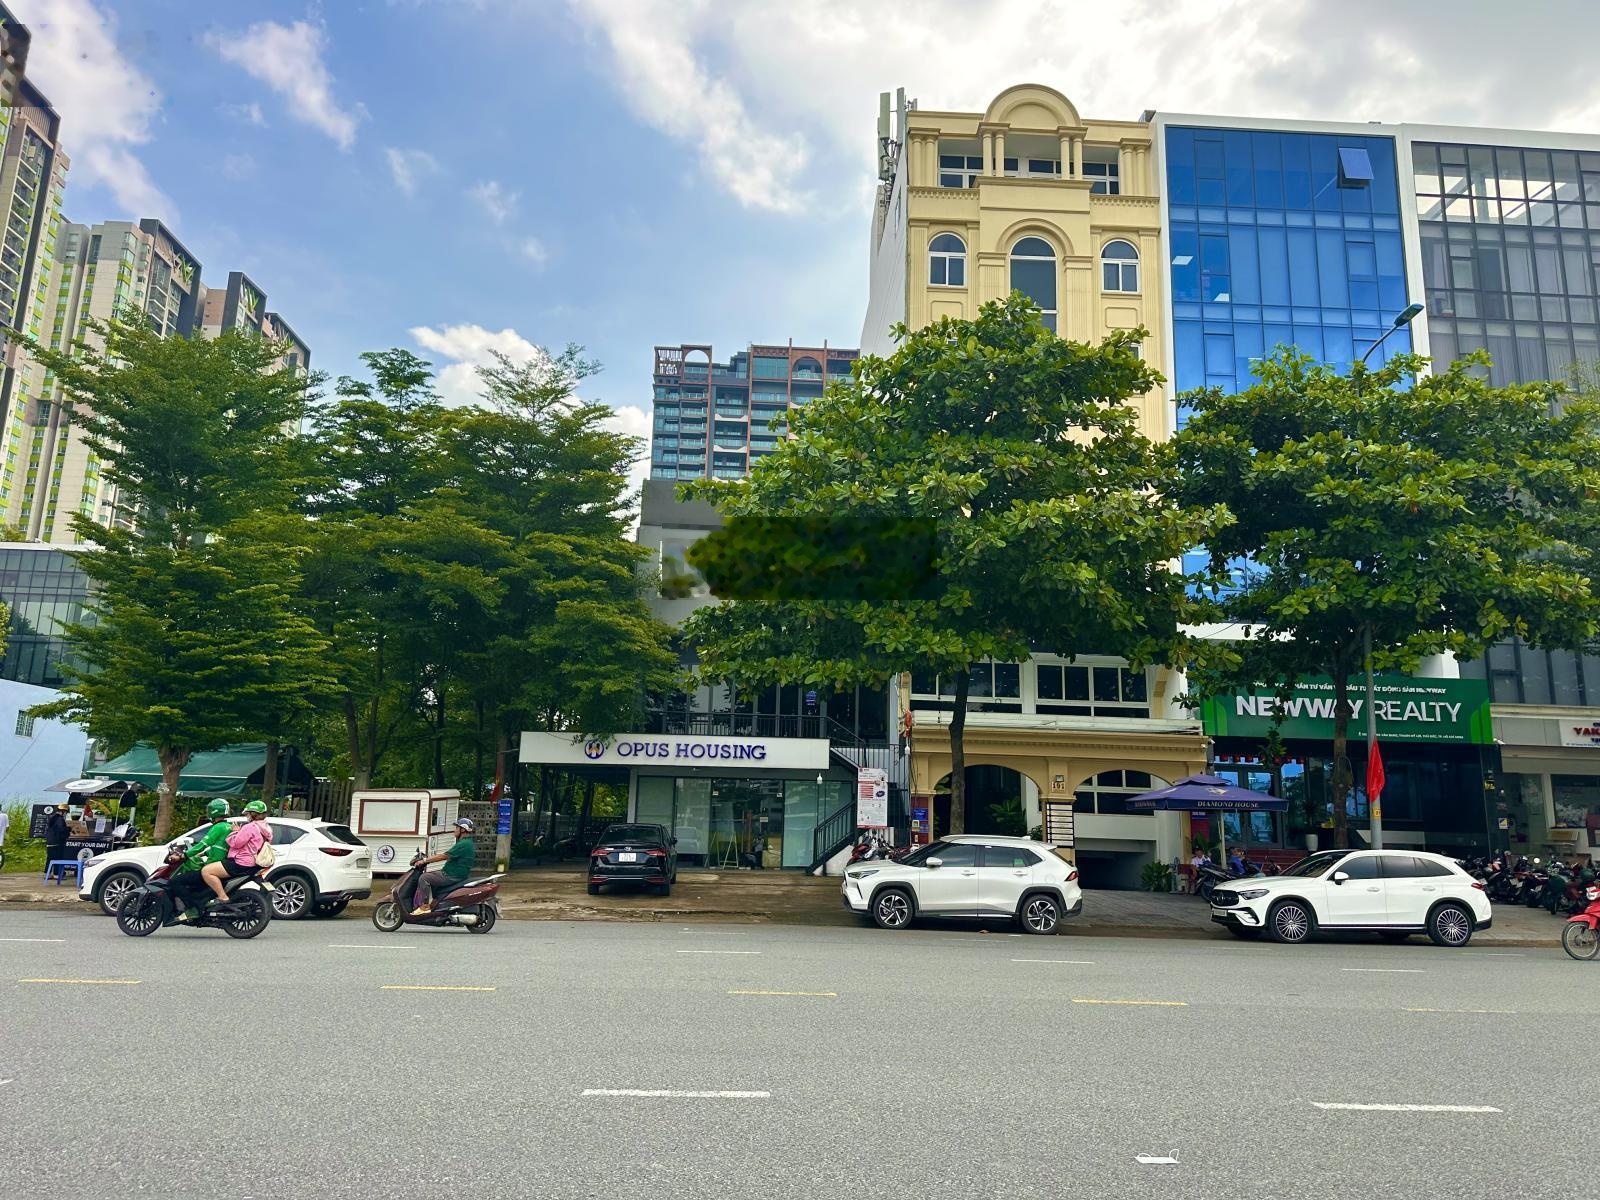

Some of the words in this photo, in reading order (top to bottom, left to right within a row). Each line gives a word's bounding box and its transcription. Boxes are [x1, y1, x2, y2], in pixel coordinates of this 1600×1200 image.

[1374, 700, 1463, 722] REALTY
[617, 742, 669, 757] OPUS
[675, 743, 766, 759] HOUSING
